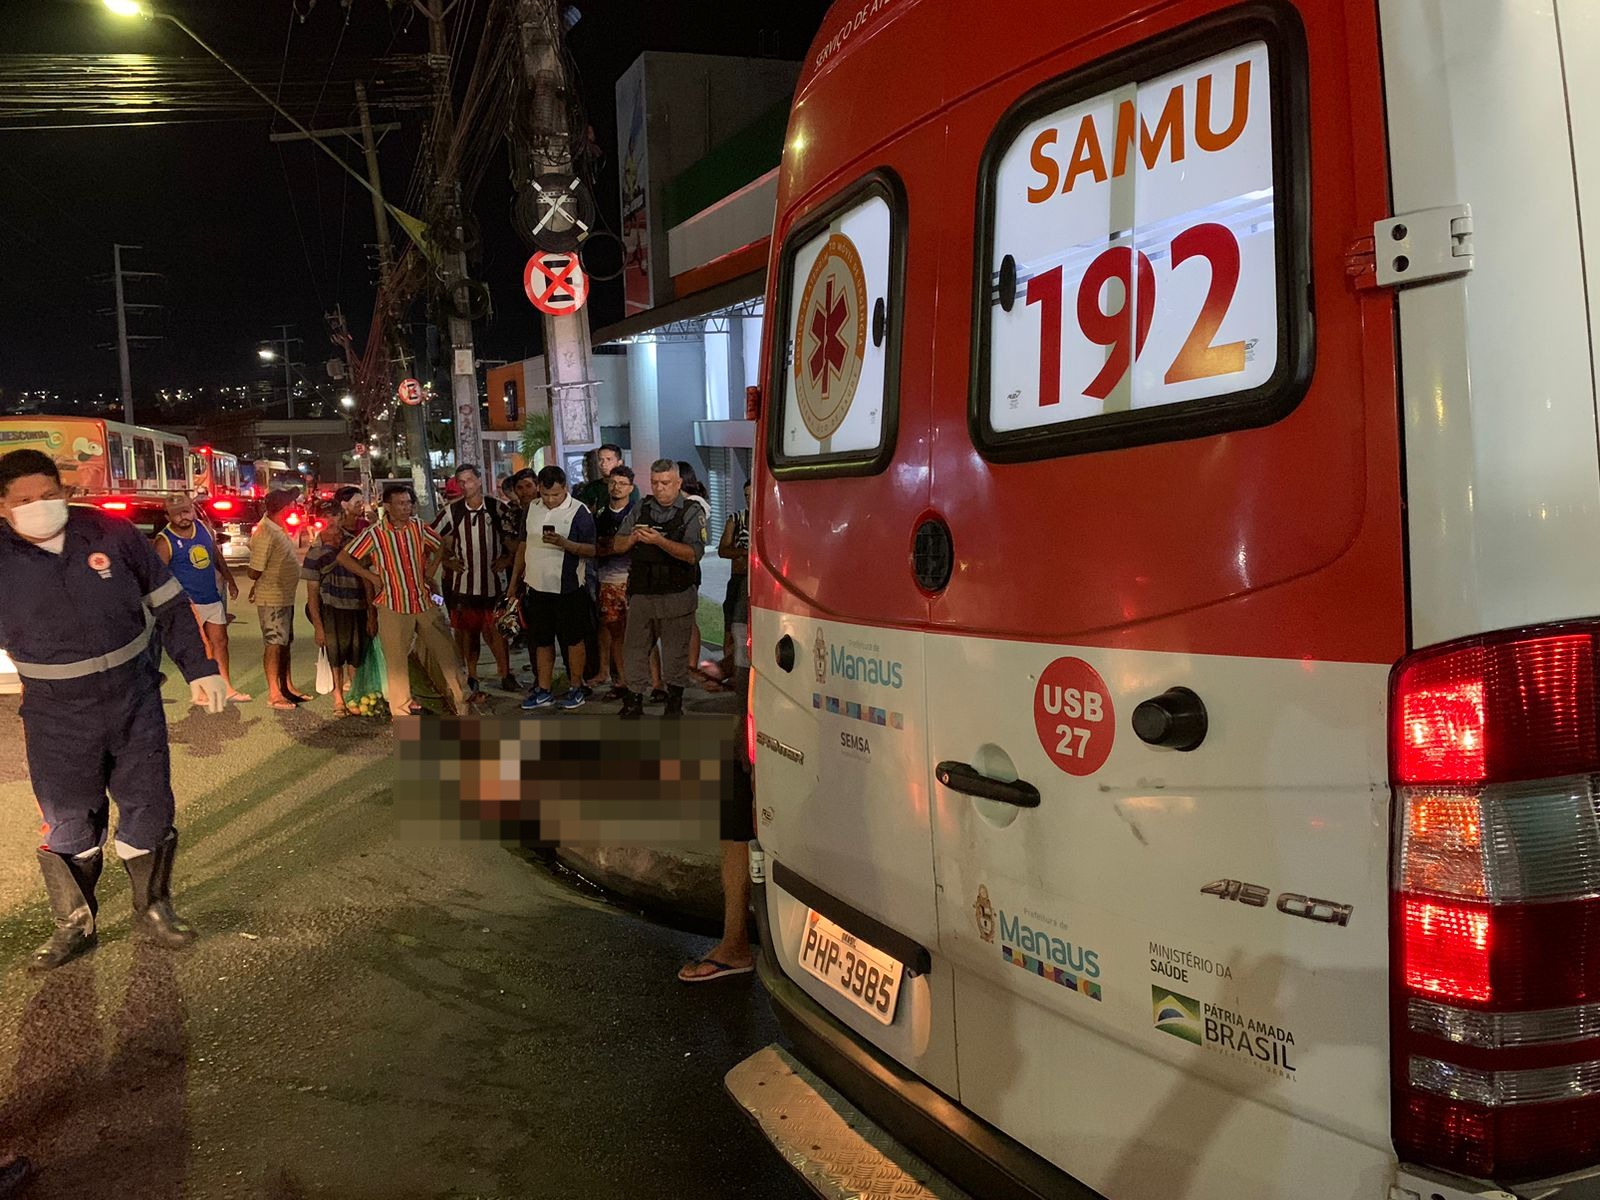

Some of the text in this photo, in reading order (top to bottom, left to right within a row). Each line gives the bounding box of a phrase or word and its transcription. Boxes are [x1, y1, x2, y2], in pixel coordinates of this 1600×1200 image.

[813, 3, 870, 72] SERVIÇO DE
[1026, 60, 1252, 204] SAMU
[1026, 222, 1246, 407] 192
[830, 644, 903, 689] Manaus
[1043, 684, 1104, 721] USB
[840, 731, 871, 754] SEMSA
[1055, 724, 1091, 759] 27
[1200, 878, 1271, 907] 415
[999, 909, 1100, 978] Manaus
[1149, 941, 1233, 980] MINISTÉRIO DA
[1150, 958, 1189, 983] SAÚDE
[1204, 1002, 1295, 1046] PÁTRIA AMADA
[1204, 1017, 1297, 1072] BRASIL
